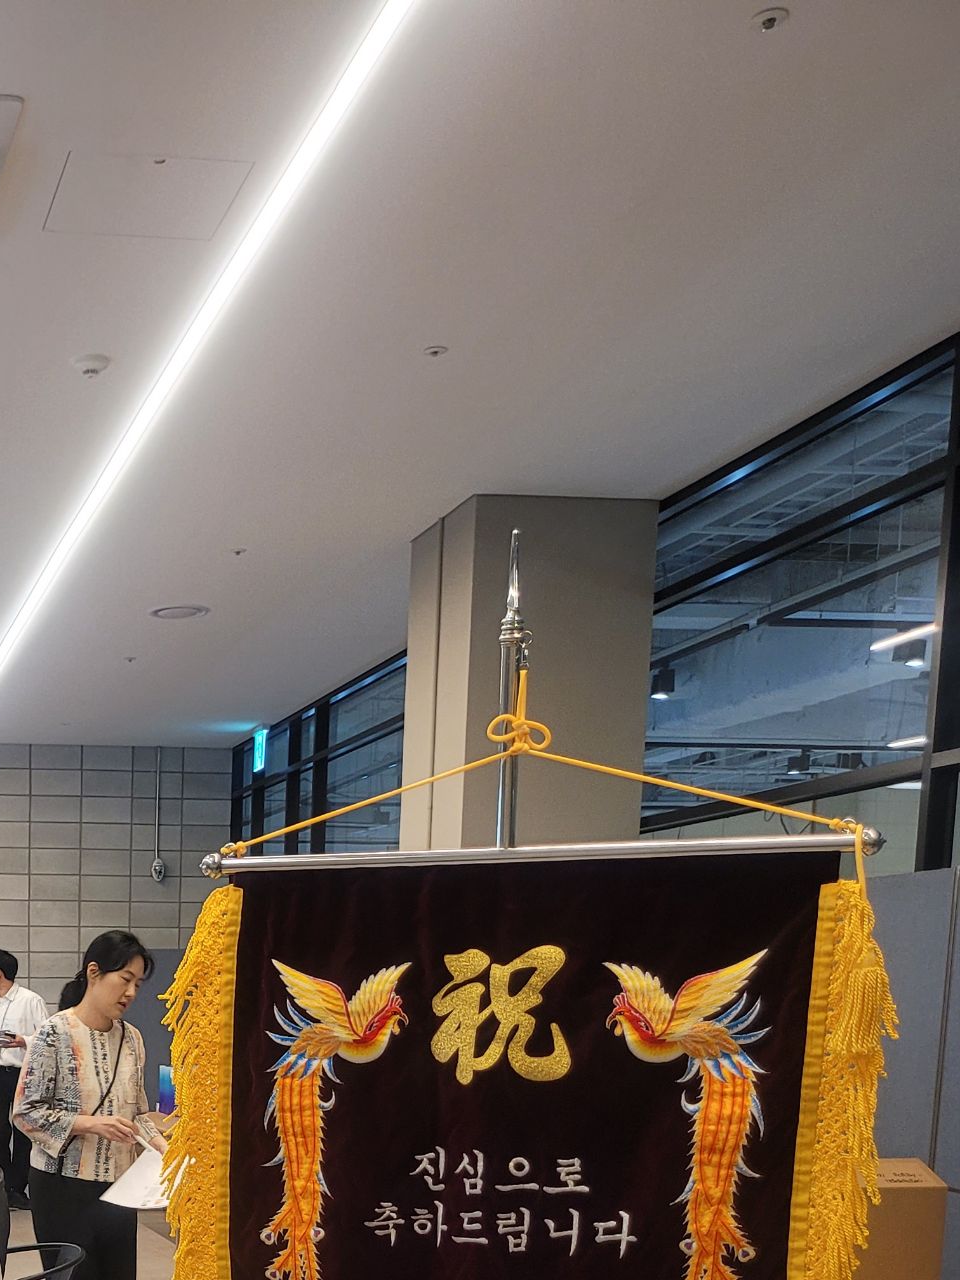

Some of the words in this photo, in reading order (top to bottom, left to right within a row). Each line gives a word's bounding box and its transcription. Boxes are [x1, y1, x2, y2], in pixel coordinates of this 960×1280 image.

[431, 944, 572, 1086] 祝
[409, 1145, 590, 1196] 진심으로
[363, 1201, 638, 1259] 축하드립니다
